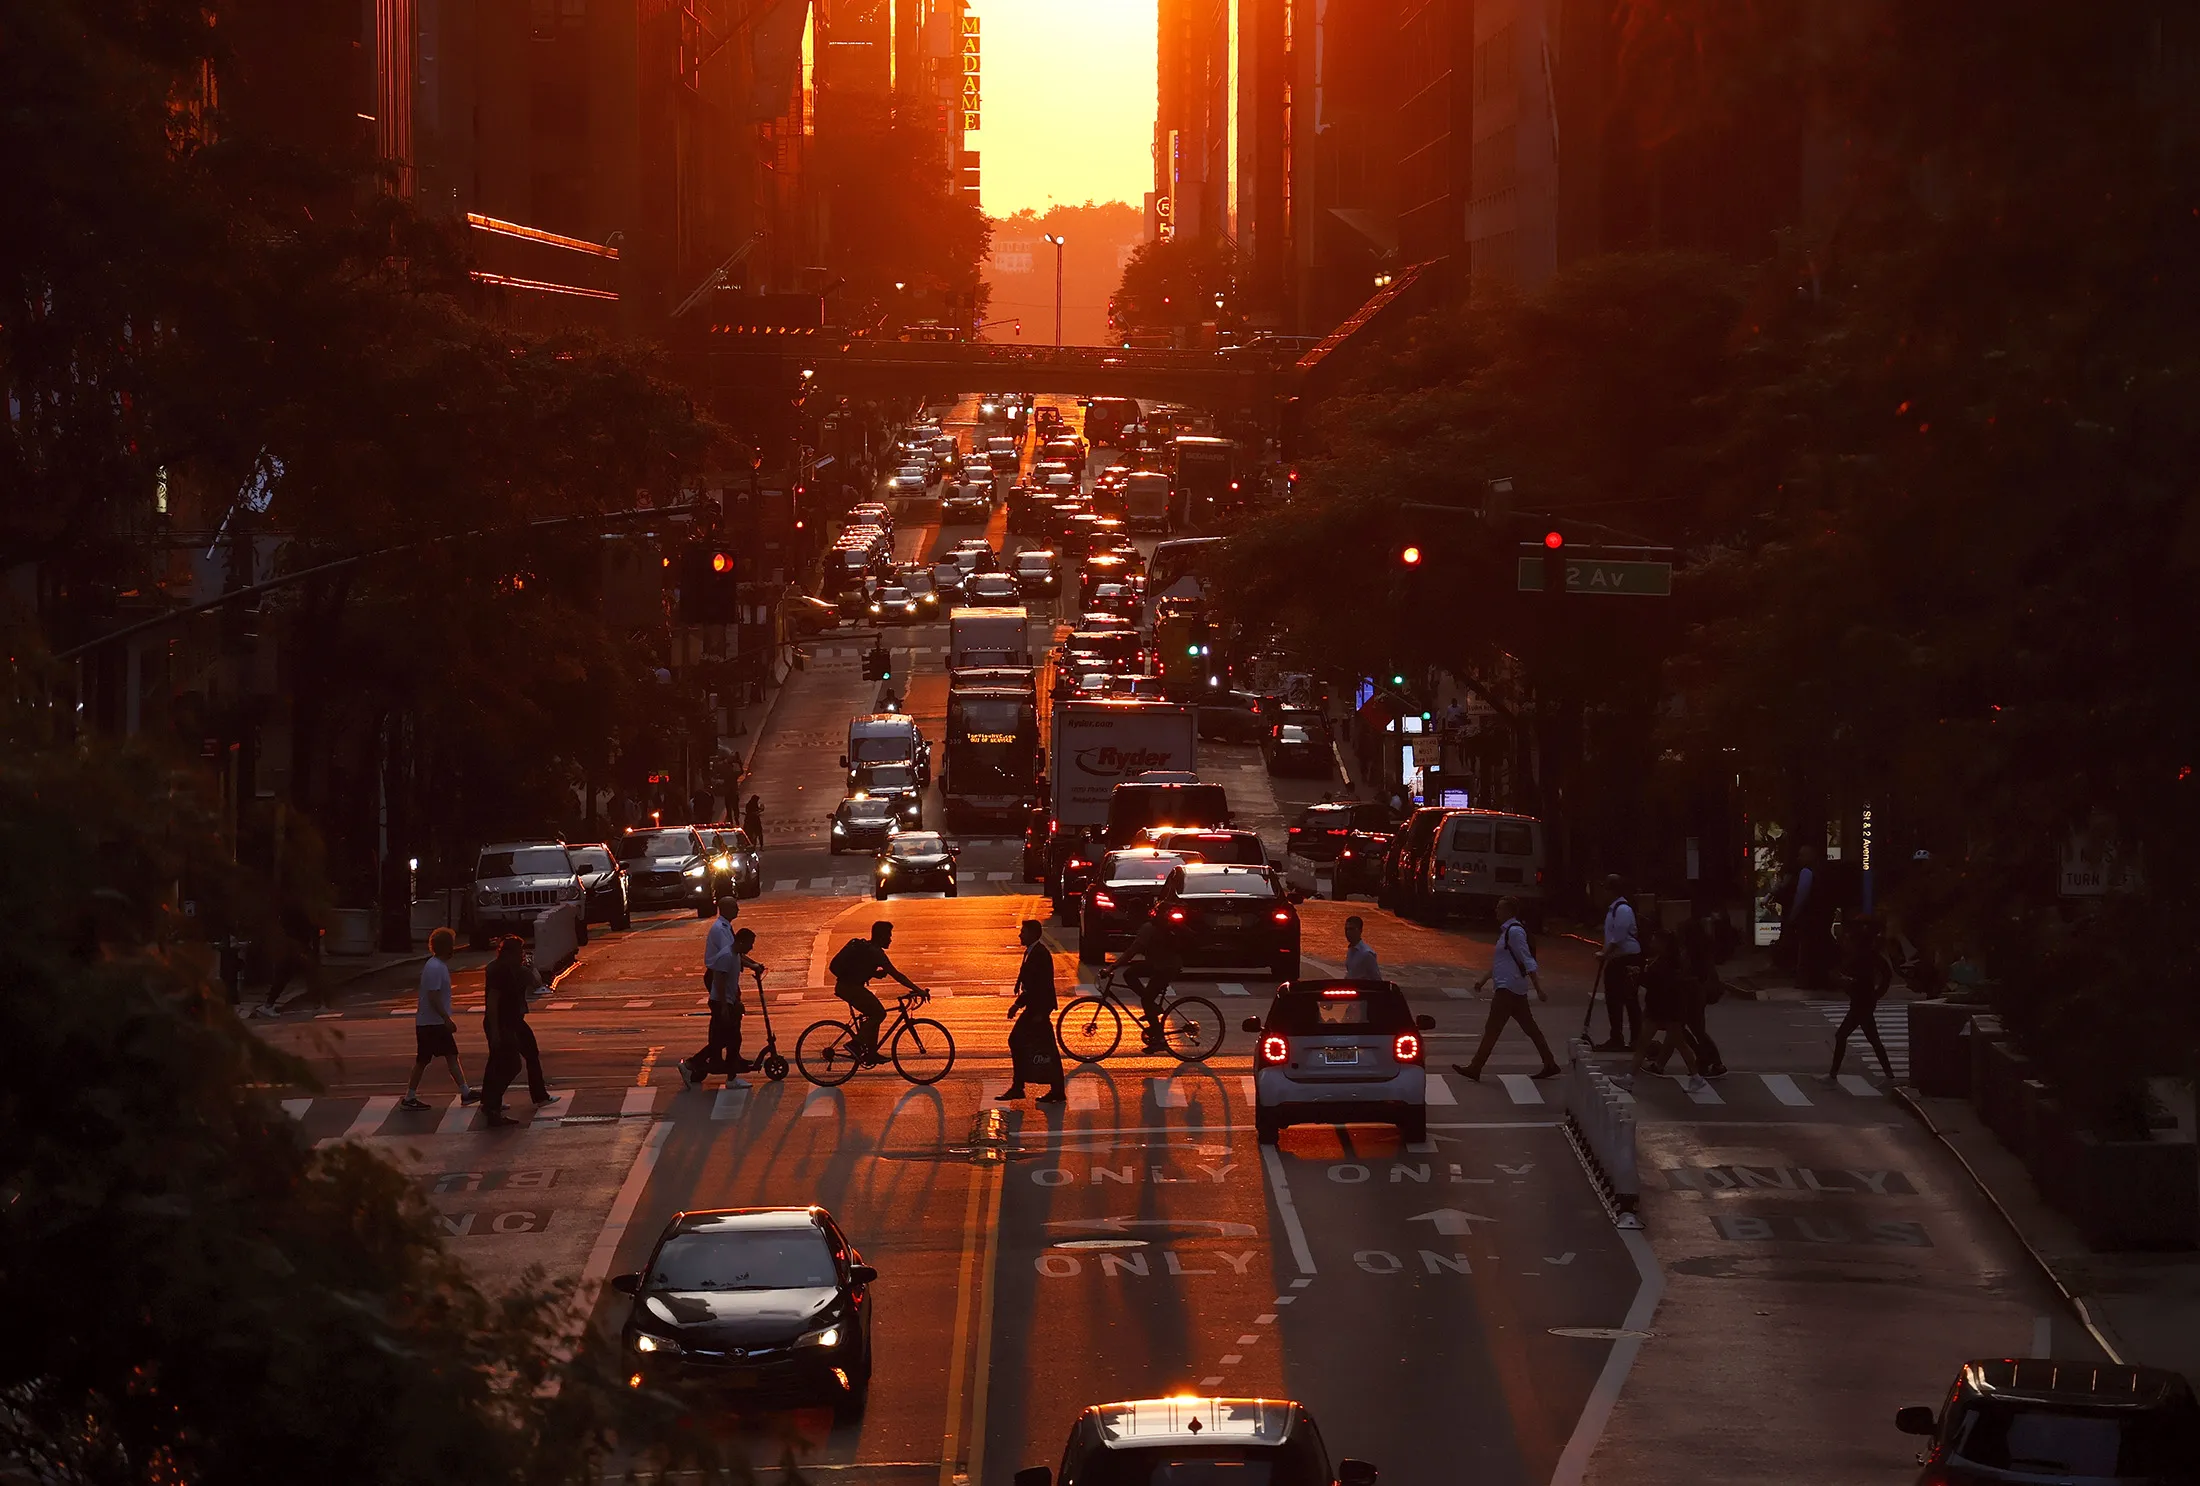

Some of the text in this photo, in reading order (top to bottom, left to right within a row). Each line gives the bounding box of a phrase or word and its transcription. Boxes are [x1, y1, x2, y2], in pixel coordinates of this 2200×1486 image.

[961, 17, 979, 131] MADAME
[1566, 567, 1624, 587] 2 Av
[1068, 720, 1114, 729] Ryder.com
[1098, 747, 1172, 770] Ryder
[1863, 811, 1871, 820] St
[1863, 839, 1871, 871] Avenue
[2066, 873, 2099, 885] TURN
[1031, 1164, 1238, 1187] ONLY
[1327, 1163, 1536, 1184] ONLY
[1719, 1215, 1921, 1245] BUS
[1034, 1251, 1258, 1277] ONLY
